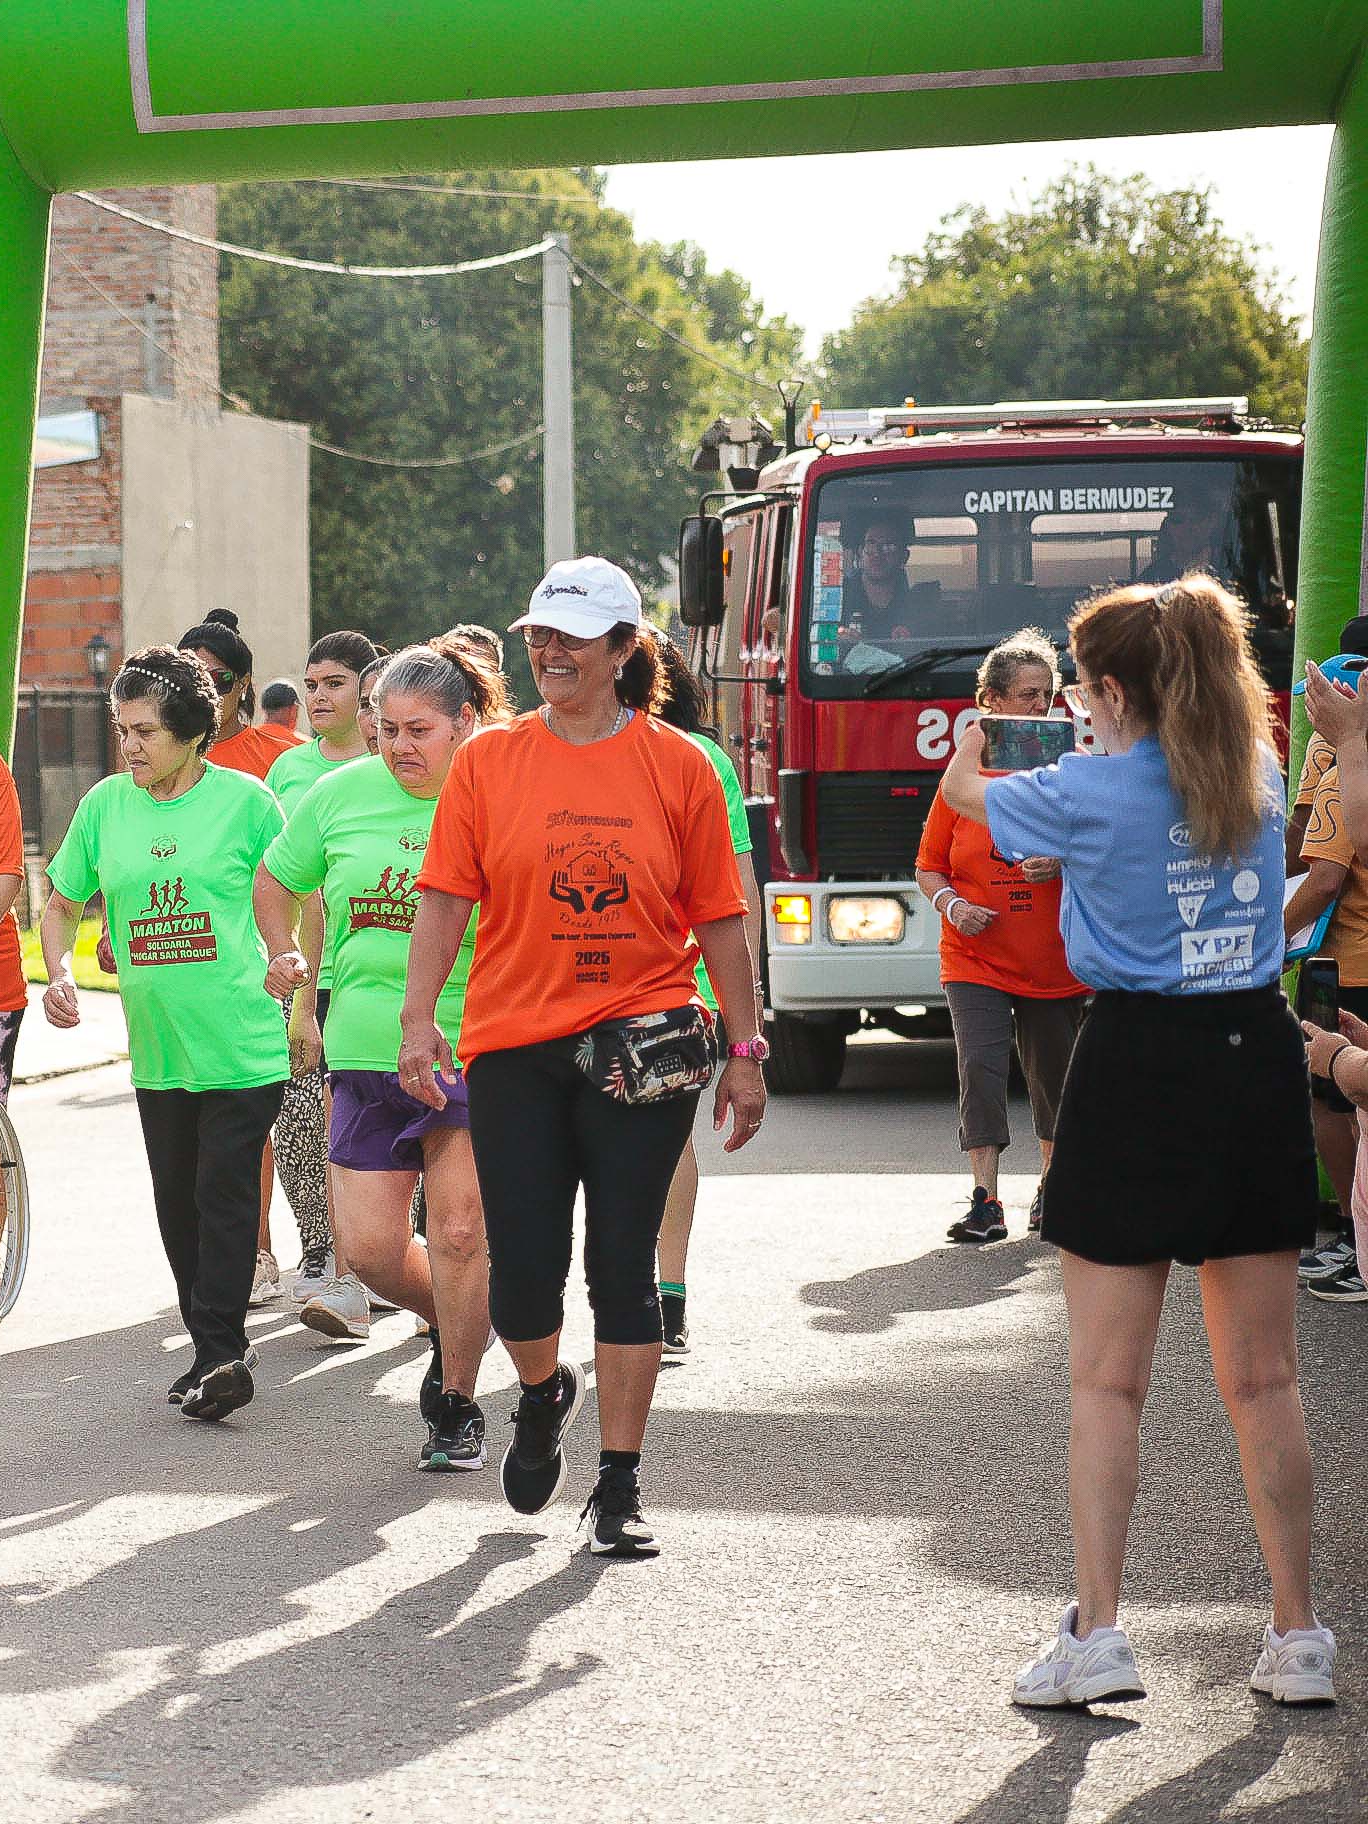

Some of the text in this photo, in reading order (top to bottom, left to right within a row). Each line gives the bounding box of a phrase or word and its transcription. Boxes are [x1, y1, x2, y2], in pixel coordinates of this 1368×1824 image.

[964, 486, 1175, 513] CAPITAN BERMUDEZ
[540, 584, 588, 599] Argentina
[353, 902, 416, 916] MARAT
[133, 914, 205, 938] MARATÓN
[146, 940, 192, 951] SOLIDARIA
[1190, 934, 1249, 956] YPF
[159, 949, 178, 960] SAN
[575, 950, 611, 967] 2025
